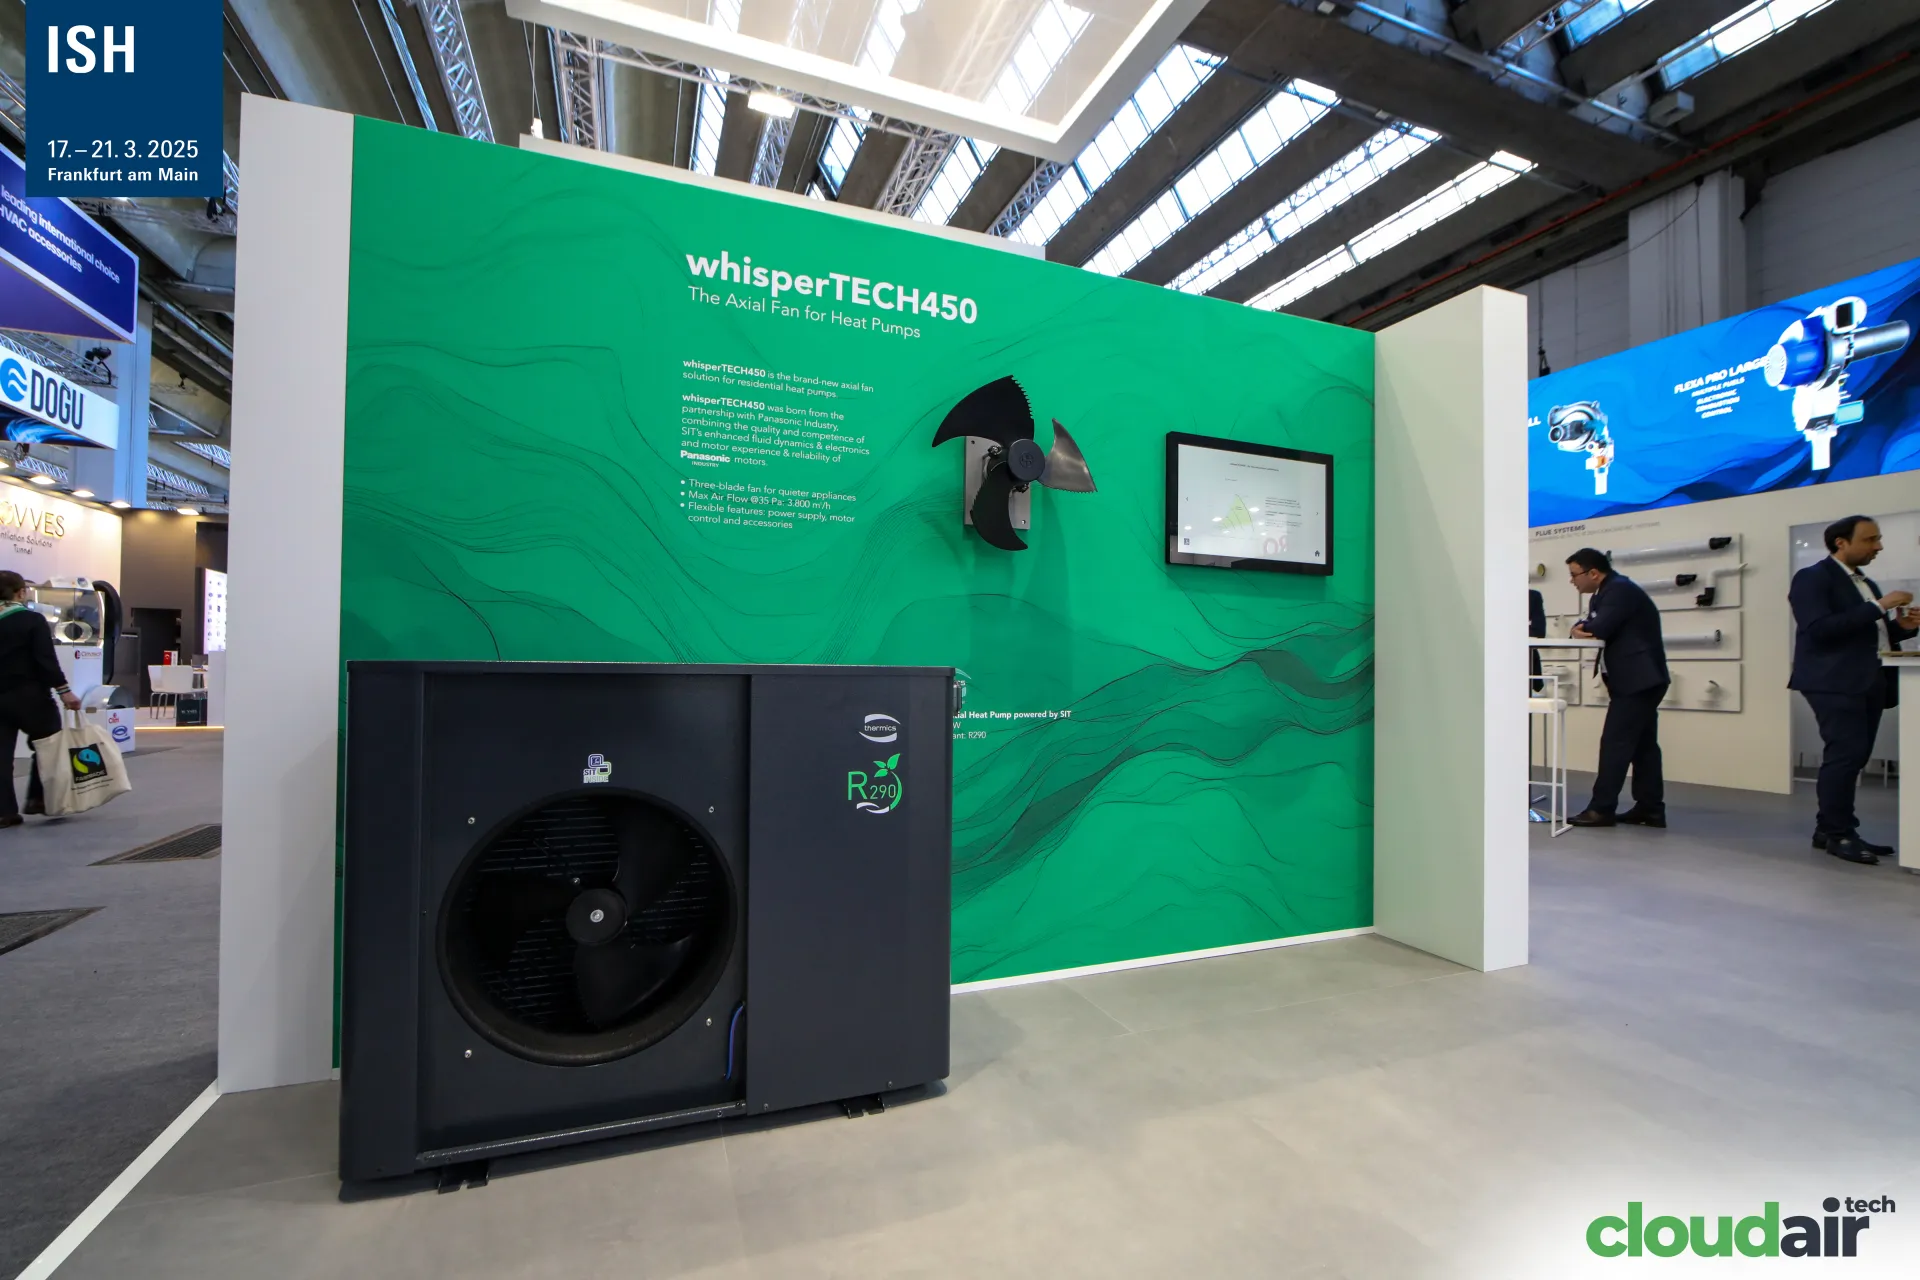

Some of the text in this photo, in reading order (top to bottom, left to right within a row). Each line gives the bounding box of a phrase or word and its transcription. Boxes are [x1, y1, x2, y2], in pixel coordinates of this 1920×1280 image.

[0, 184, 121, 284] leading international choice
[28, 227, 83, 274] accessories
[686, 251, 977, 324] whisperTECH450
[688, 286, 921, 339] The Axial Fan for Heat Pumps
[683, 360, 765, 377] whisperTECH450
[777, 372, 791, 381] the
[793, 374, 838, 388] brand-new
[841, 380, 859, 390] axial
[862, 383, 874, 393] fan
[683, 371, 838, 399] solution for residential heat pumps.
[1674, 377, 1704, 394] FLEXA
[1705, 370, 1727, 385] PRO
[31, 369, 84, 430] DOĞU
[682, 394, 844, 420] whisperTECH450 was born from the
[682, 406, 839, 431] partnership with Panasonic Industry,
[682, 417, 865, 444] combining the quality and competence of
[681, 439, 841, 463] and motor experience & reliability of
[705, 431, 749, 442] enhanced
[752, 434, 771, 444] fluid
[774, 436, 814, 449] dynamics
[816, 442, 823, 450] &
[826, 443, 869, 455] electronics
[681, 450, 768, 466] Panasonic motors.
[689, 479, 856, 502] Three-blade fan for quieter appliances
[689, 491, 708, 499] Max
[711, 492, 724, 501] Air
[727, 494, 748, 503] Flow
[750, 496, 770, 504] @35
[772, 498, 785, 506] Pa:
[788, 499, 810, 508] 3.800
[688, 502, 855, 523] Flexible features: power supply, motor
[688, 514, 793, 529] control and accessories
[1536, 527, 1551, 537] FLUE
[1554, 525, 1586, 534] SYSTEMS
[990, 712, 1011, 720] Pump
[1014, 711, 1047, 719] powered
[1049, 711, 1058, 719] by
[968, 731, 986, 739] R290
[848, 771, 896, 800] R290
